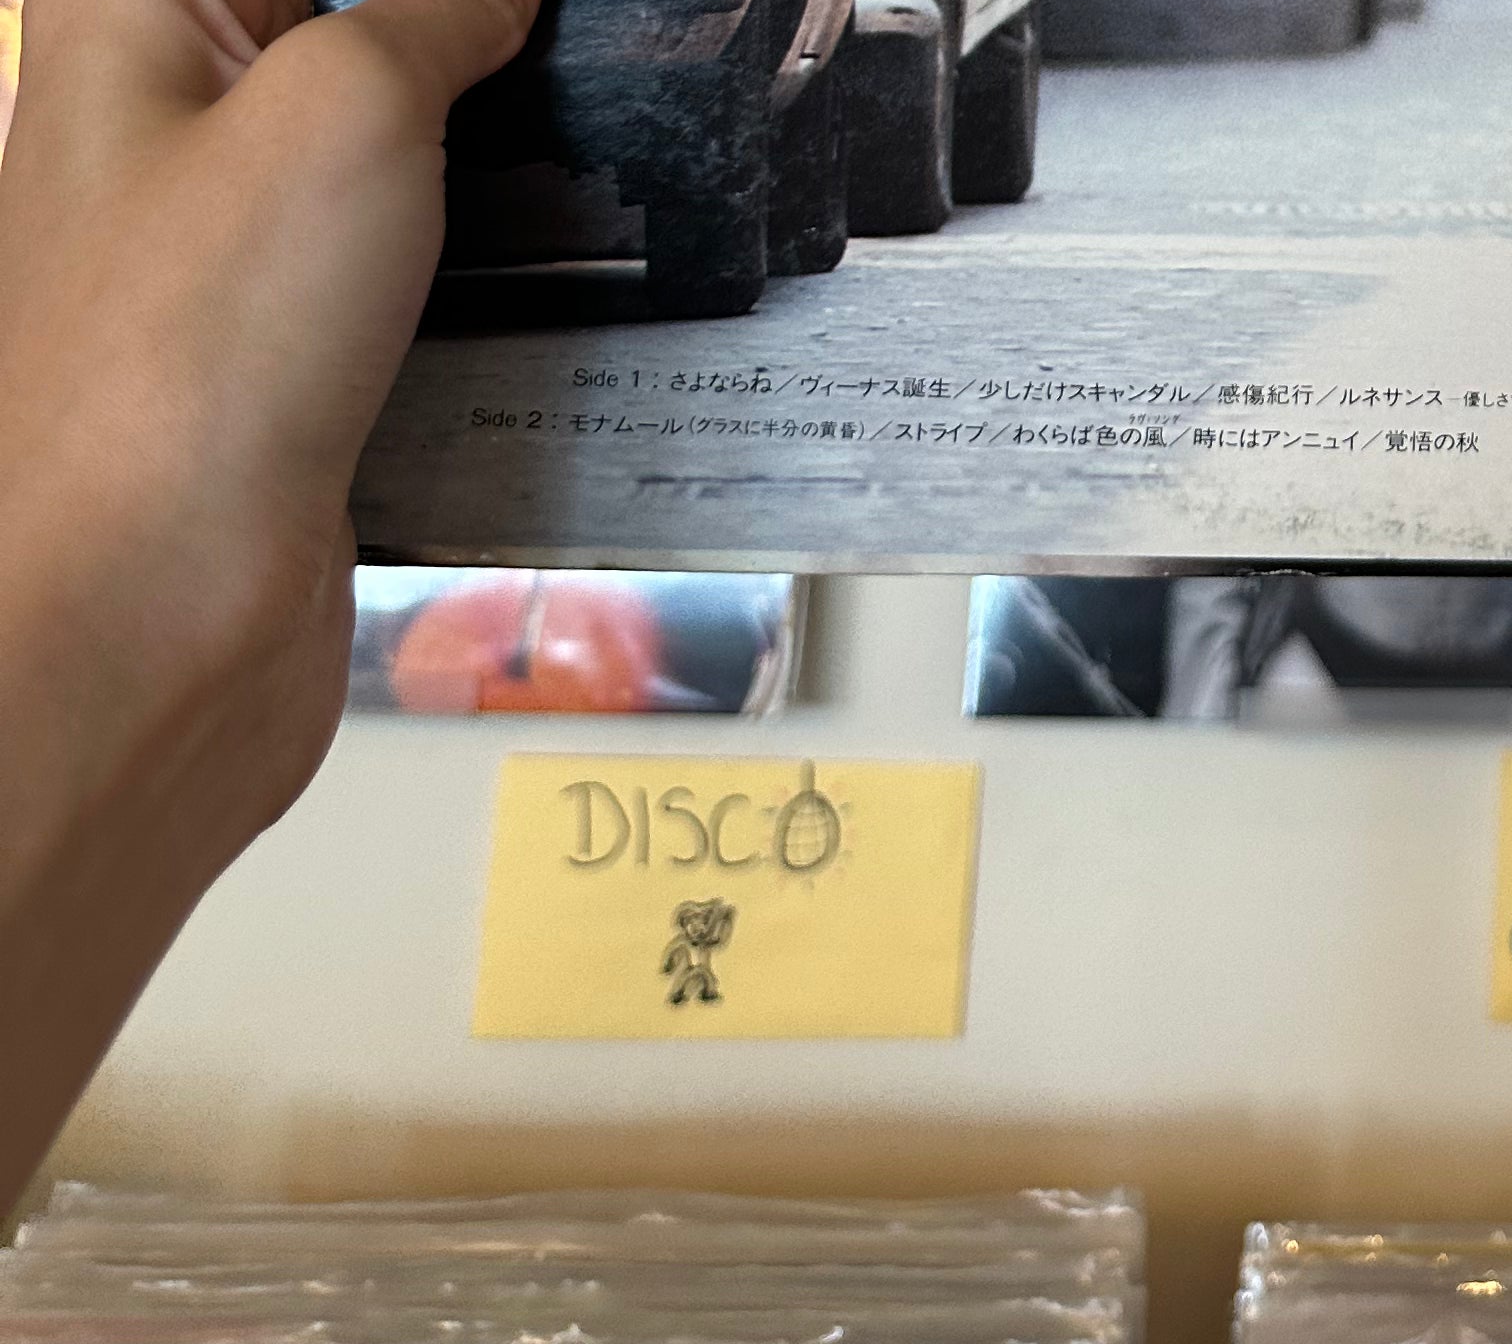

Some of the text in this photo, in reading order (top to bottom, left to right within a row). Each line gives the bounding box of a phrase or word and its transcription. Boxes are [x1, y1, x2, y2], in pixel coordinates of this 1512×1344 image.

[573, 367, 619, 388] Side
[471, 407, 518, 428] Side
[560, 759, 846, 874] DISCO
